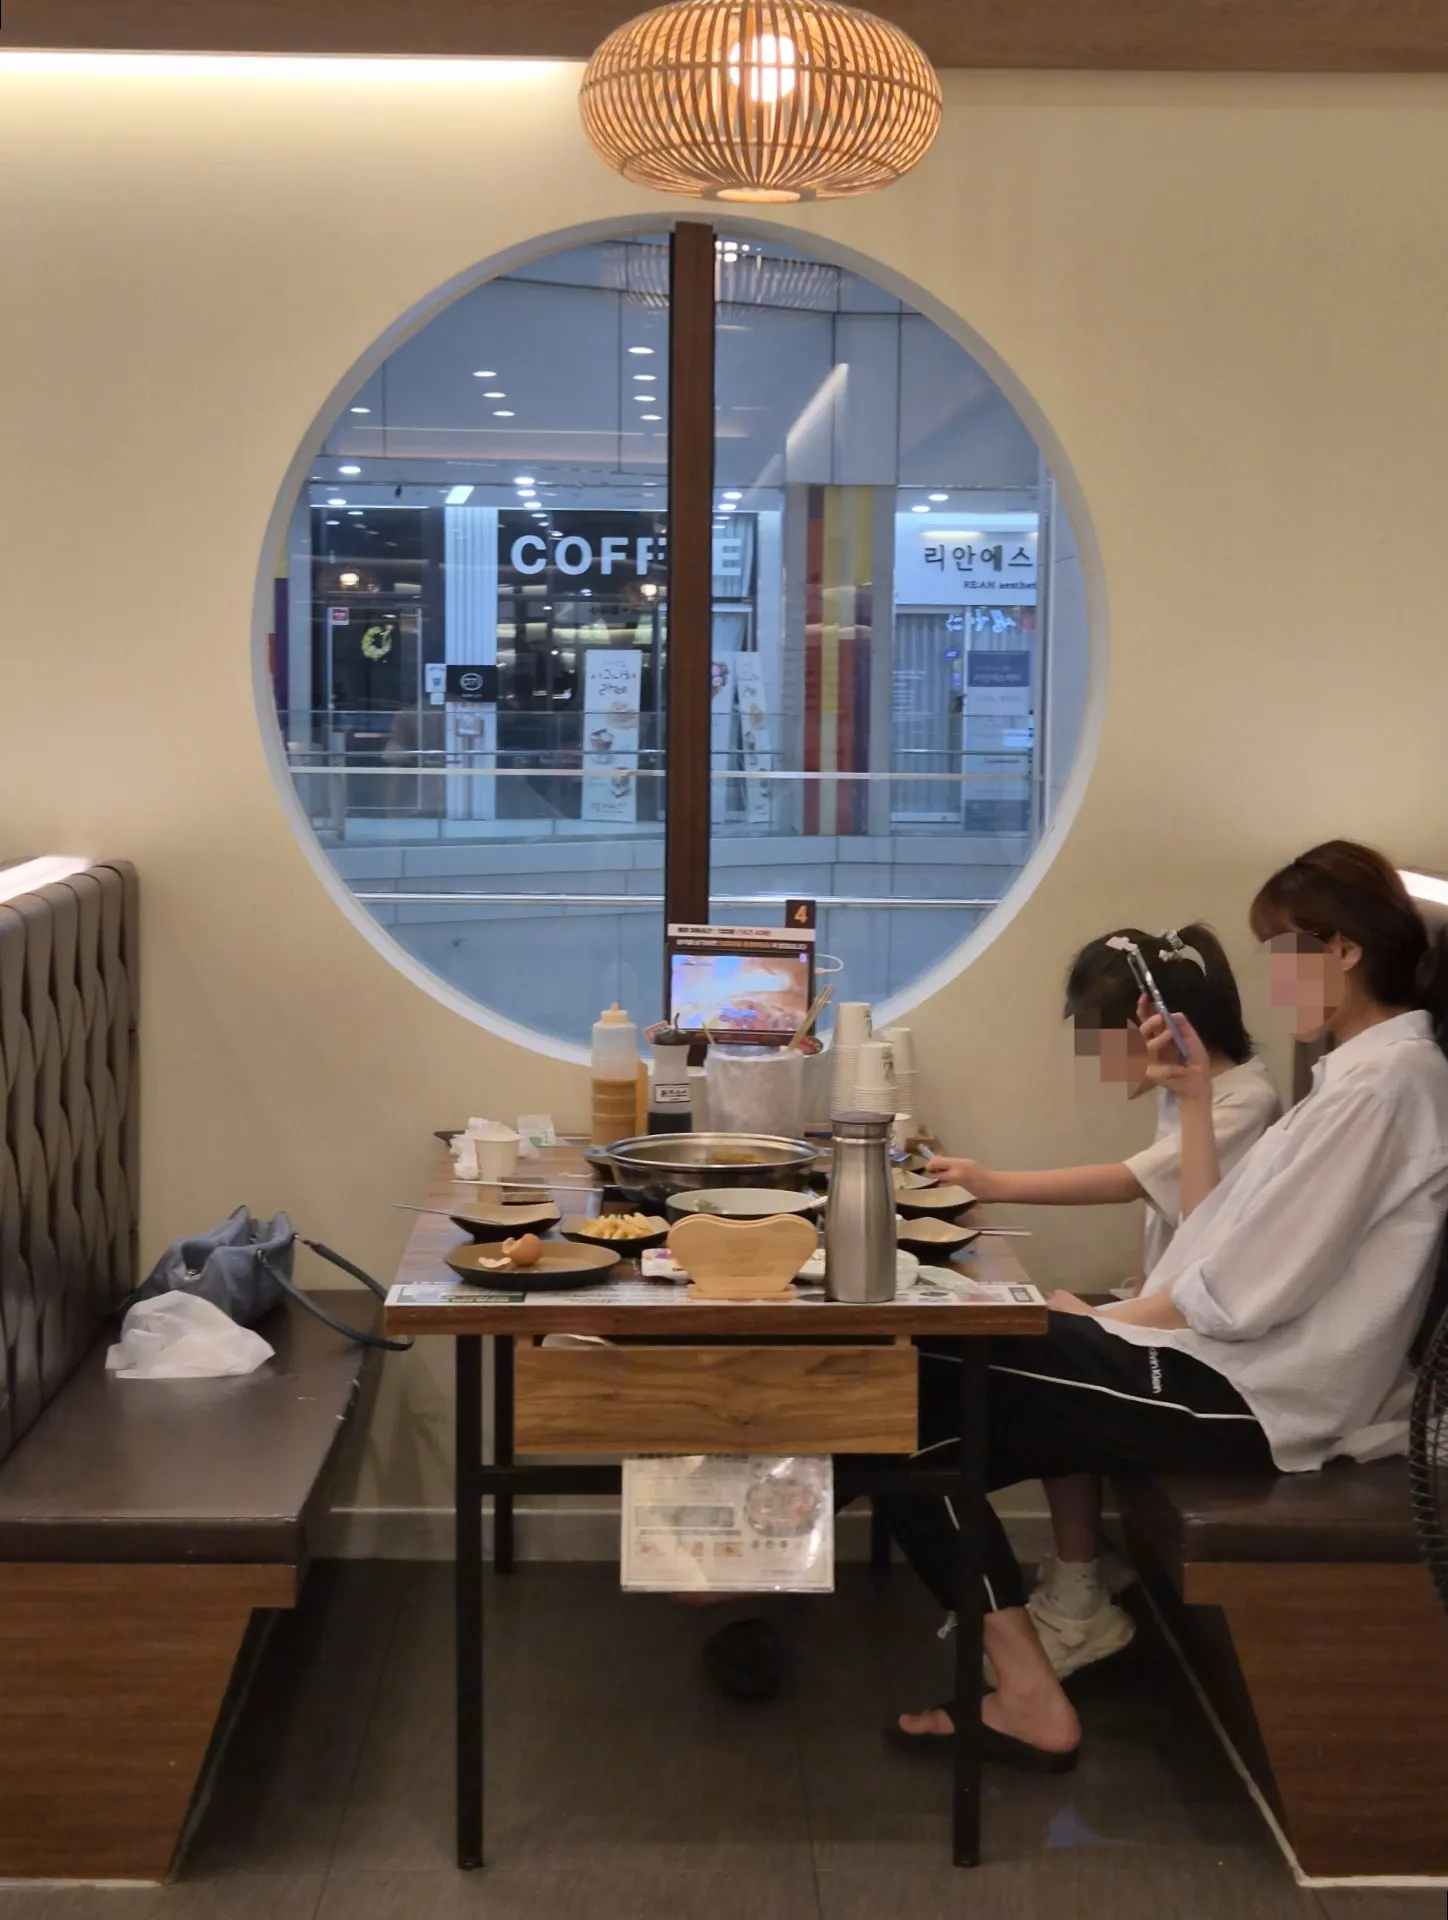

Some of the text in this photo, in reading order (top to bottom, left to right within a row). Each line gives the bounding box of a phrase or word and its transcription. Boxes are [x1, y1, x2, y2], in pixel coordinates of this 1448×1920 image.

[510, 534, 742, 576] COFFE
[924, 544, 1033, 572] 리안에스
[793, 904, 808, 924] 4
